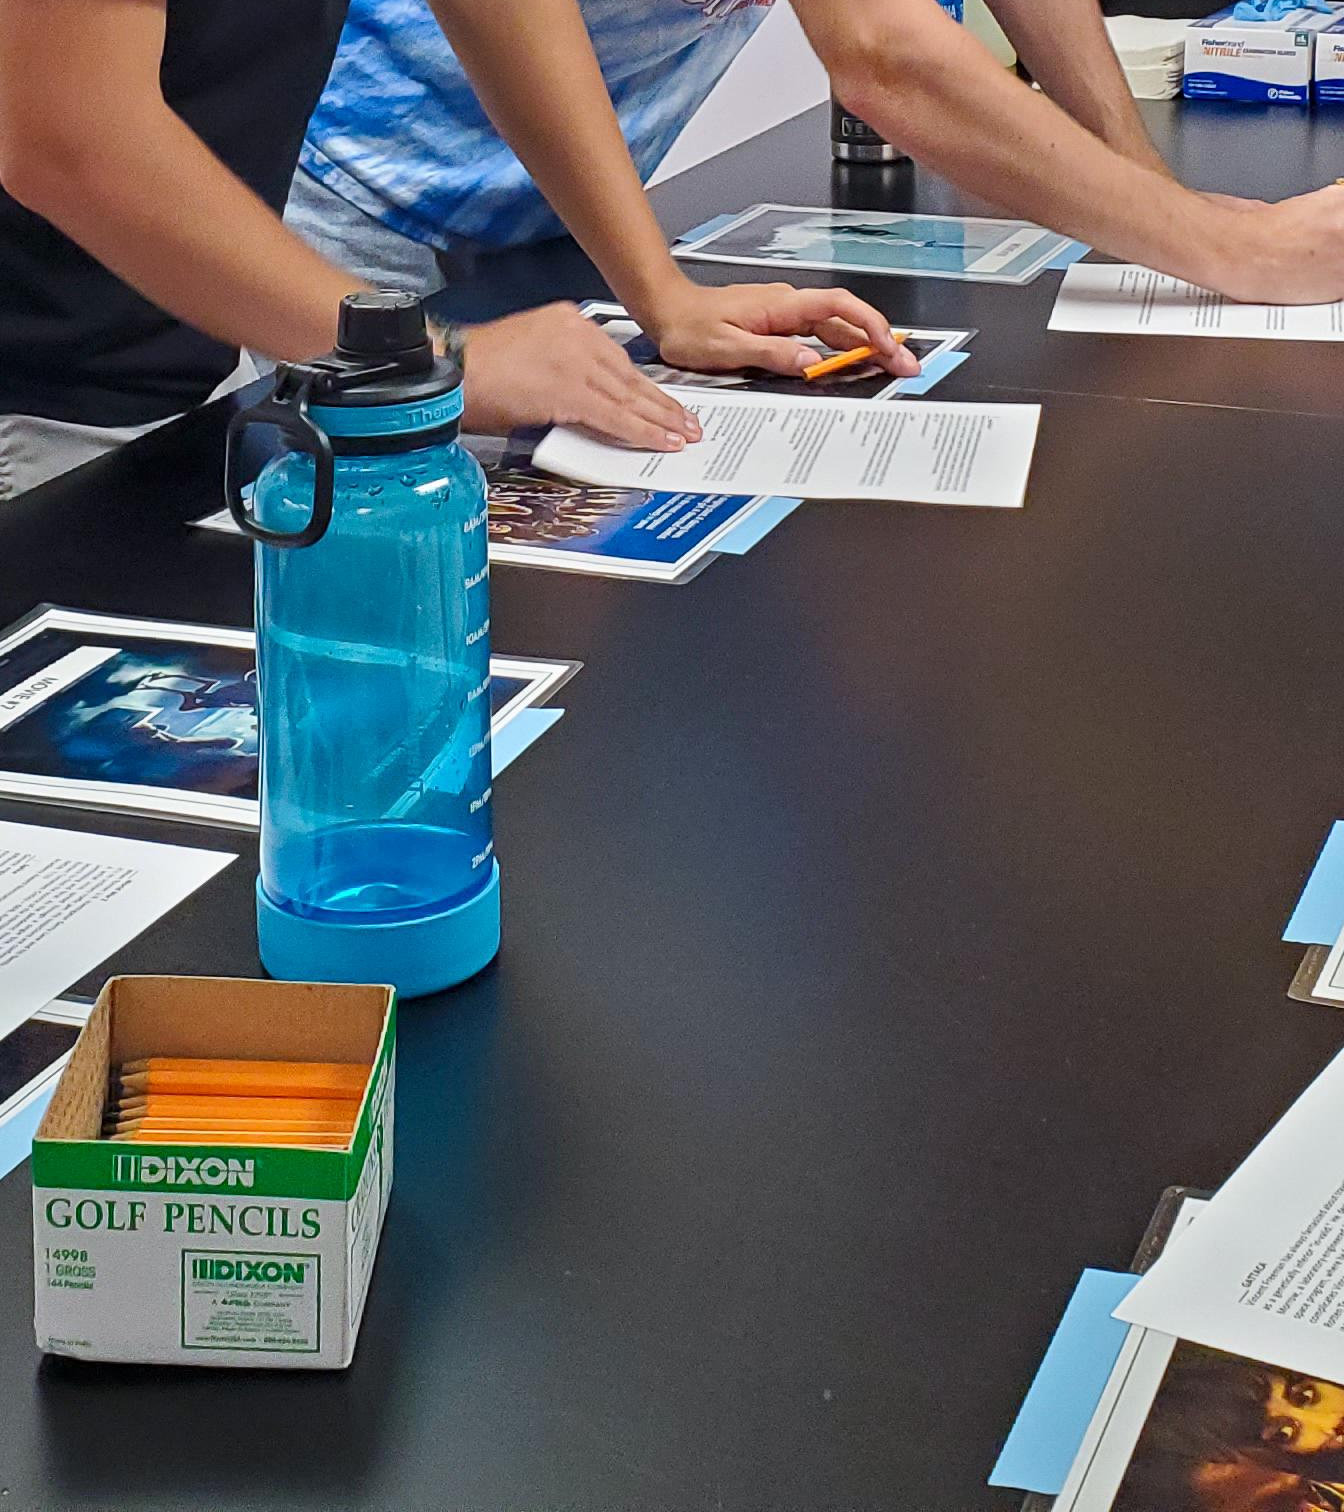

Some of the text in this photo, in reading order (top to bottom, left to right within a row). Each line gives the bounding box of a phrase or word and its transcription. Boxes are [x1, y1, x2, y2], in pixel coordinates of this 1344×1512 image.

[1203, 47, 1242, 57] NITRILE
[141, 1155, 255, 1187] DIXON
[46, 1198, 321, 1239] GOLF PENCILS
[56, 1264, 96, 1278] GROSS
[213, 1259, 304, 1283] DIXON
[1241, 1263, 1267, 1288] GATTACA
